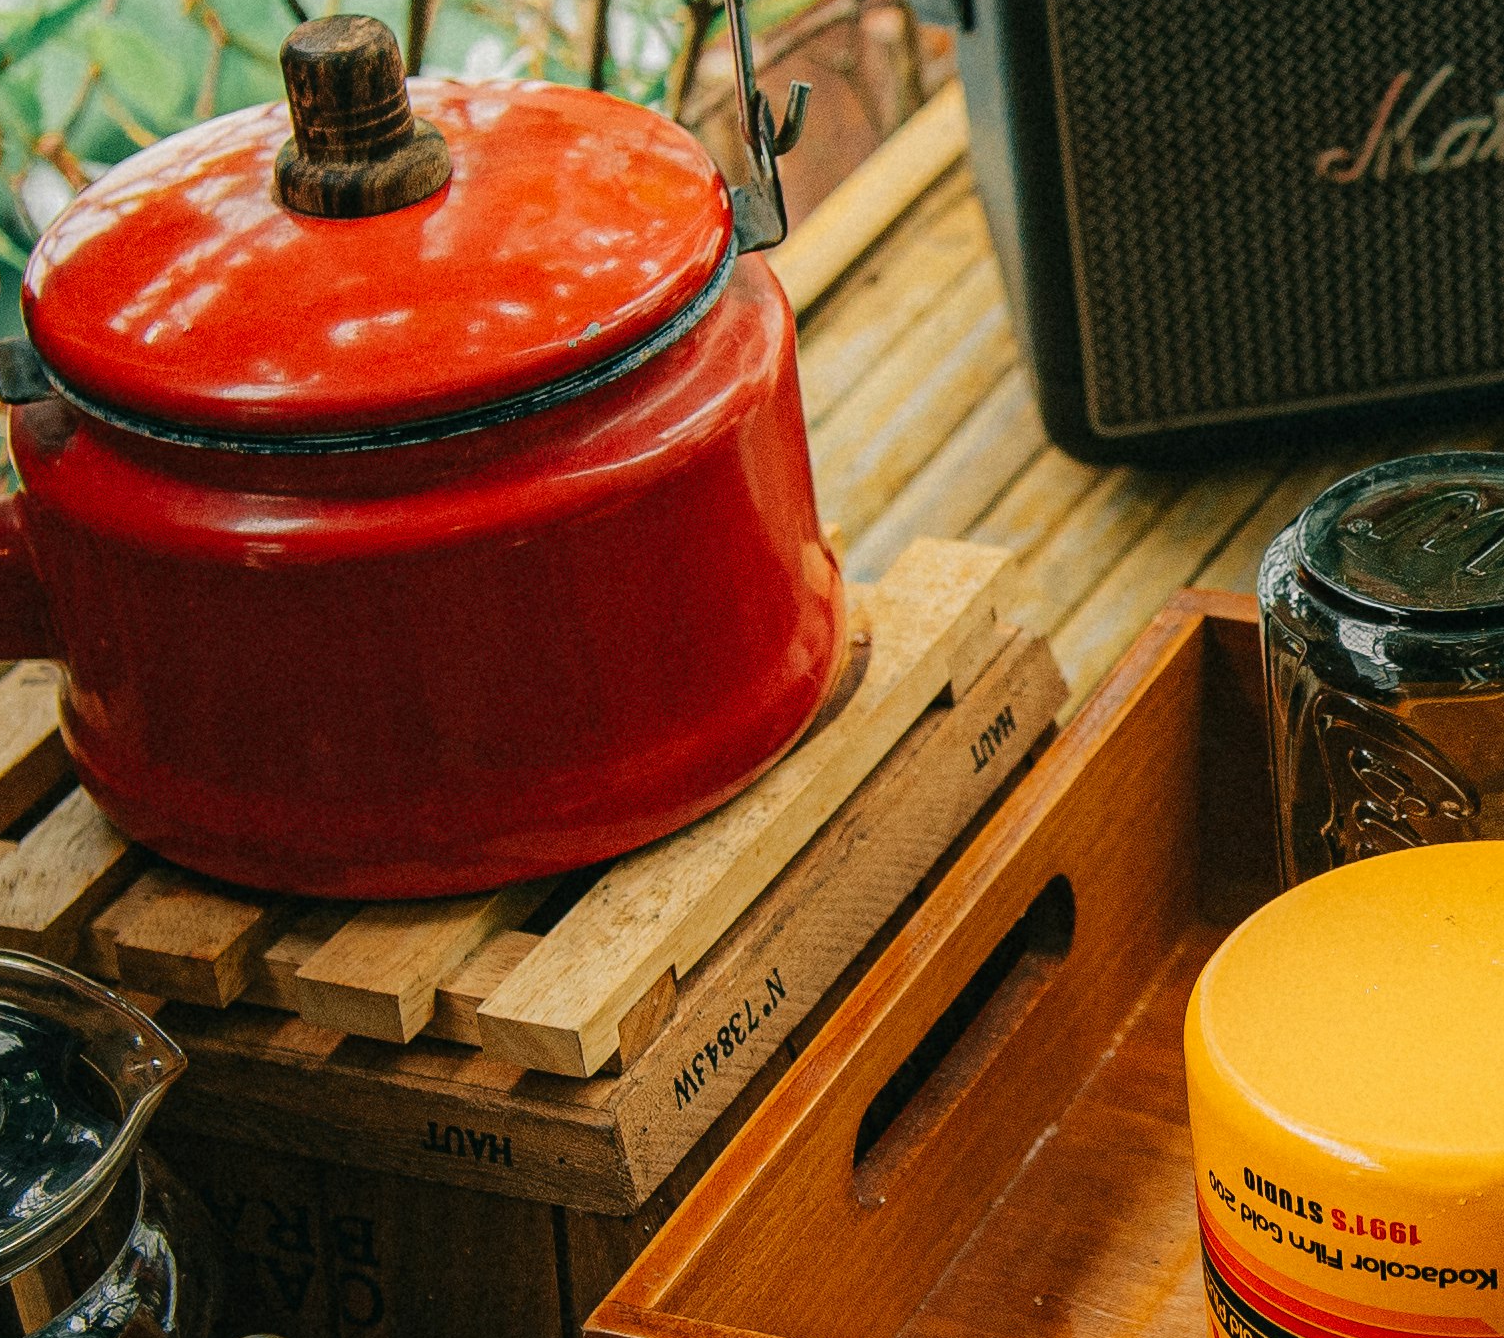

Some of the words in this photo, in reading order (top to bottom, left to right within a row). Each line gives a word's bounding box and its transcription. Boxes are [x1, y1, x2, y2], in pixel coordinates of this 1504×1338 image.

[972, 705, 1017, 774] HAUT
[422, 1119, 514, 1169] HAUT
[1208, 1169, 1237, 1213] 200
[1243, 1166, 1324, 1225] STUDIO
[1241, 1203, 1284, 1244] Gold
[1330, 1207, 1423, 1246] 1991'S
[1288, 1229, 1344, 1272] Film
[1350, 1252, 1498, 1290] Kodacolor
